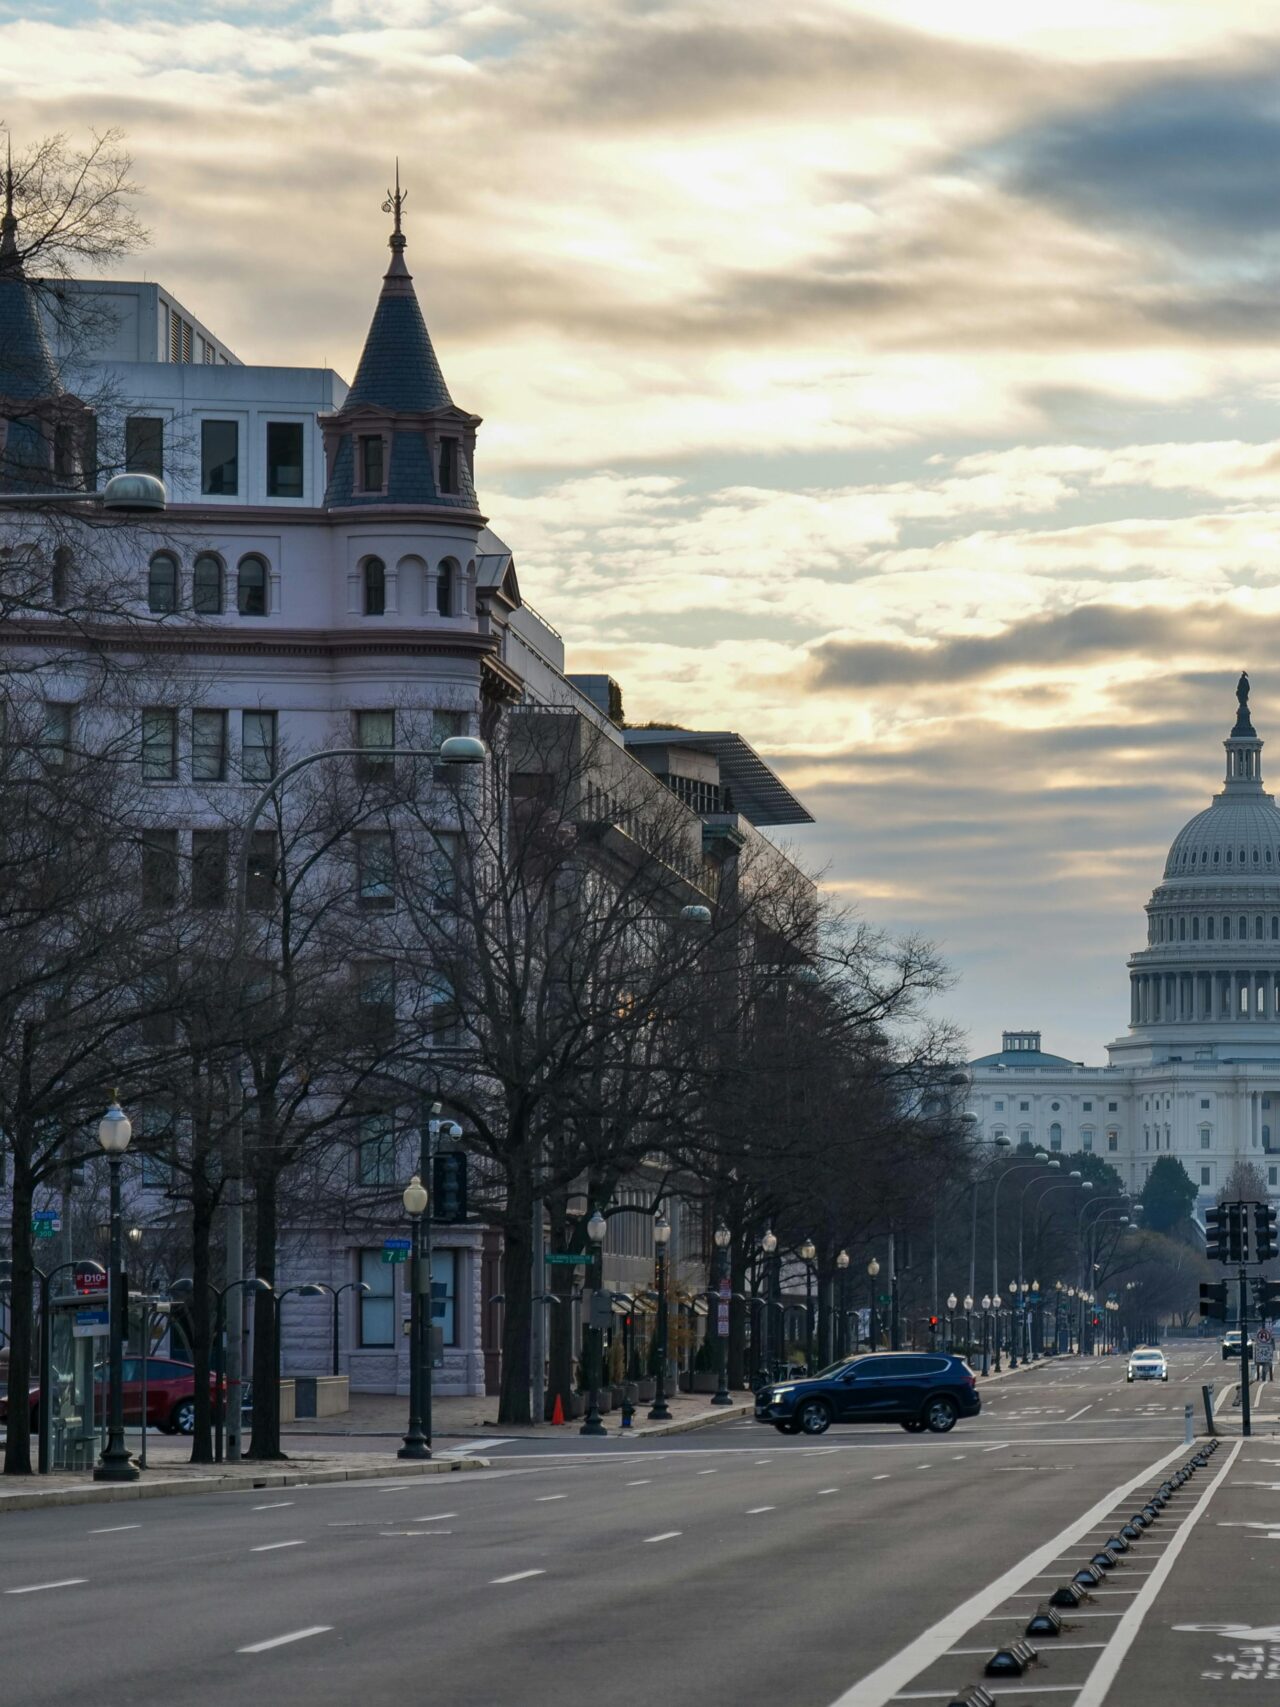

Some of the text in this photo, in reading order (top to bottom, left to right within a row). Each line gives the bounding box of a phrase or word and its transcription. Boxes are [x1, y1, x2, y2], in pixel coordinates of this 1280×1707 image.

[33, 1221, 40, 1231] 7
[387, 1251, 395, 1262] 7
[84, 1274, 101, 1283] D10
